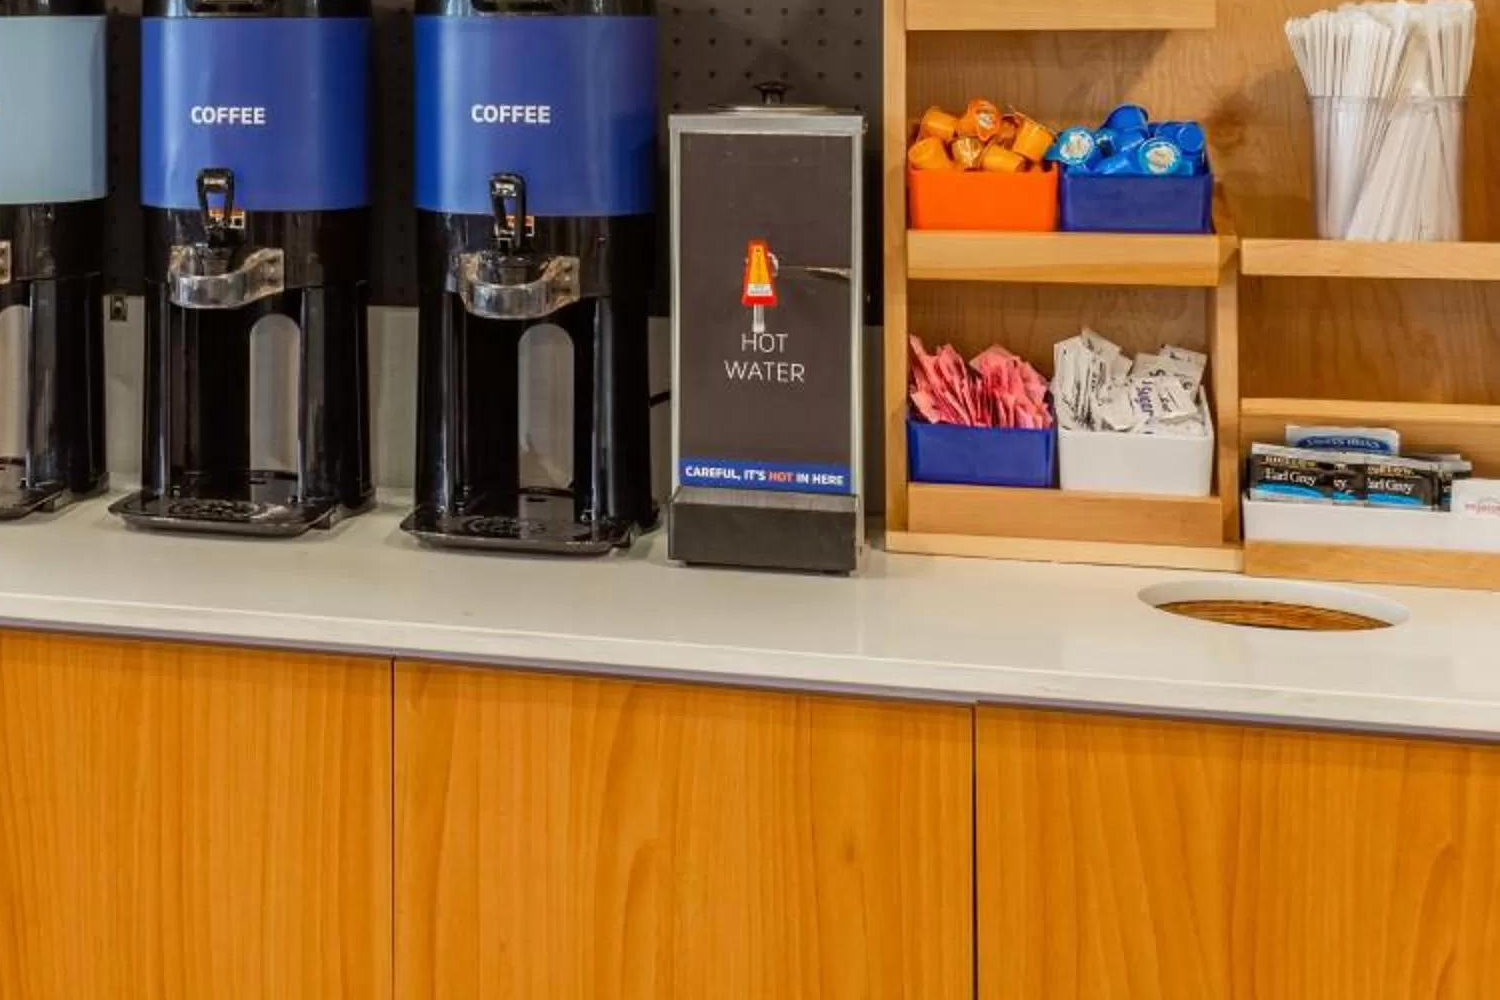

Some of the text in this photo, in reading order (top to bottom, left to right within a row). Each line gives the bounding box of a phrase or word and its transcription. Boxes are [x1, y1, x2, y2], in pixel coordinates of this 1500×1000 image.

[190, 106, 267, 125] COFFEE
[470, 104, 552, 124] COFFEE
[741, 333, 789, 353] HOT
[723, 360, 806, 383] WATER
[685, 466, 845, 486] CAREFUL, IT'S HOT IN HERE
